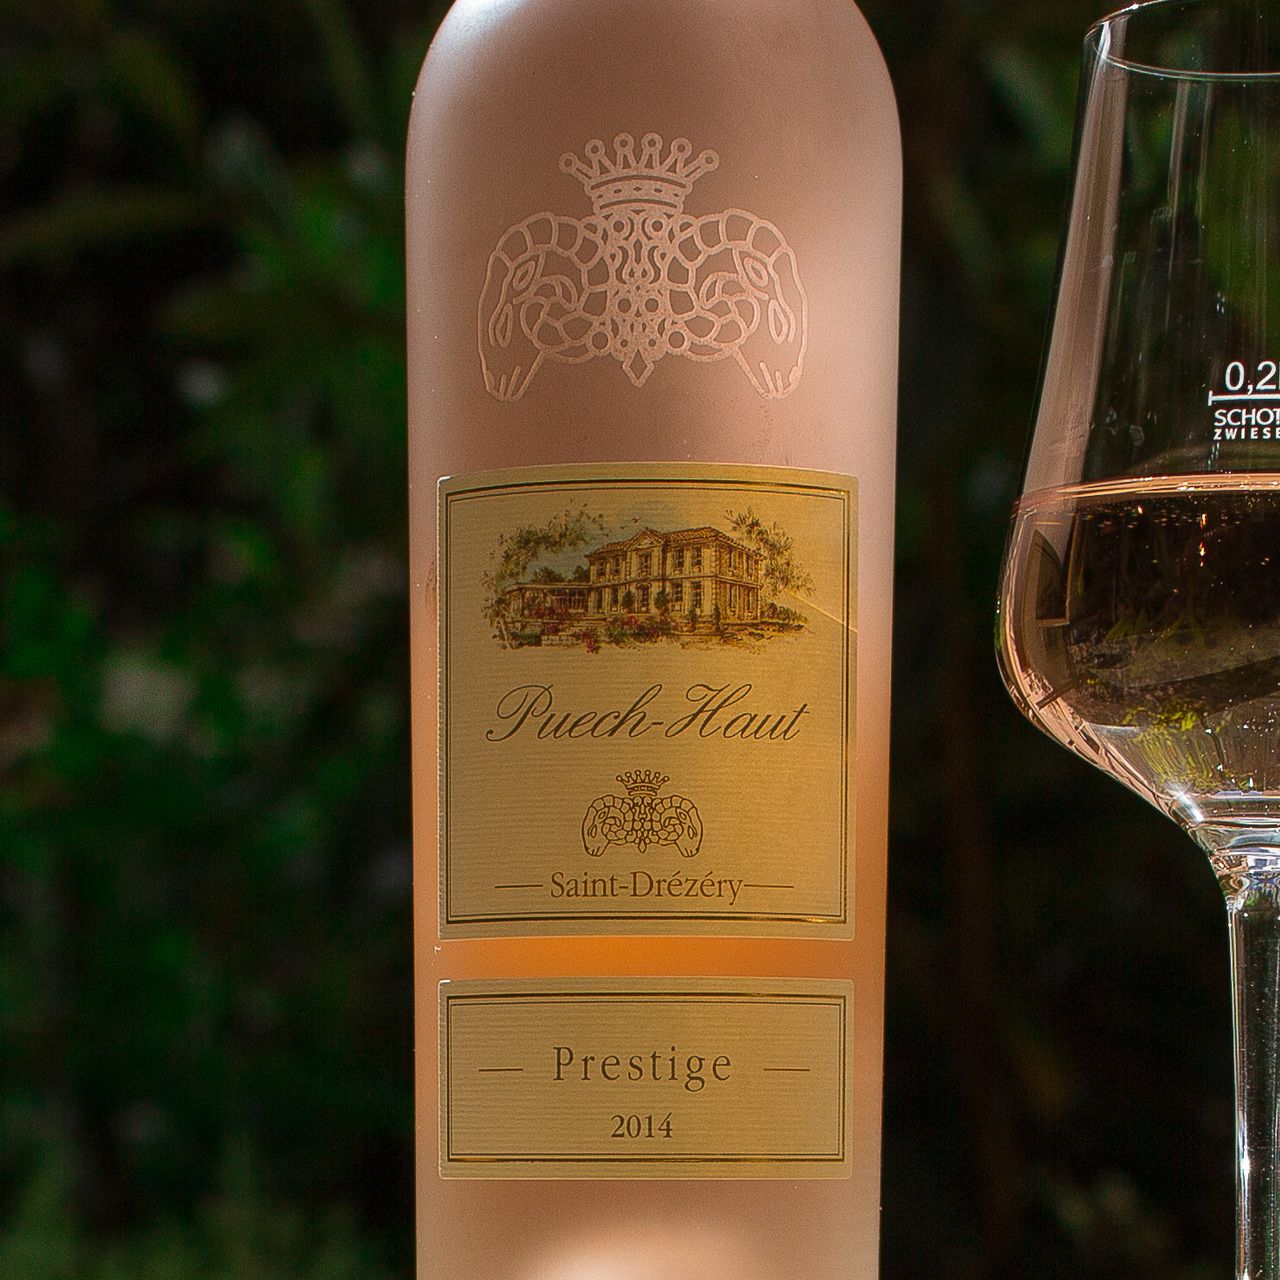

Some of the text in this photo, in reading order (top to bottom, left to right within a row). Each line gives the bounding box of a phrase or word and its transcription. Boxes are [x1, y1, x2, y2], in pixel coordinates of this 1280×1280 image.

[485, 683, 810, 742] Puech-Haut
[549, 871, 744, 905] Saint-Drézéry
[551, 1045, 732, 1093] Prestige
[610, 1112, 674, 1138] 2014
